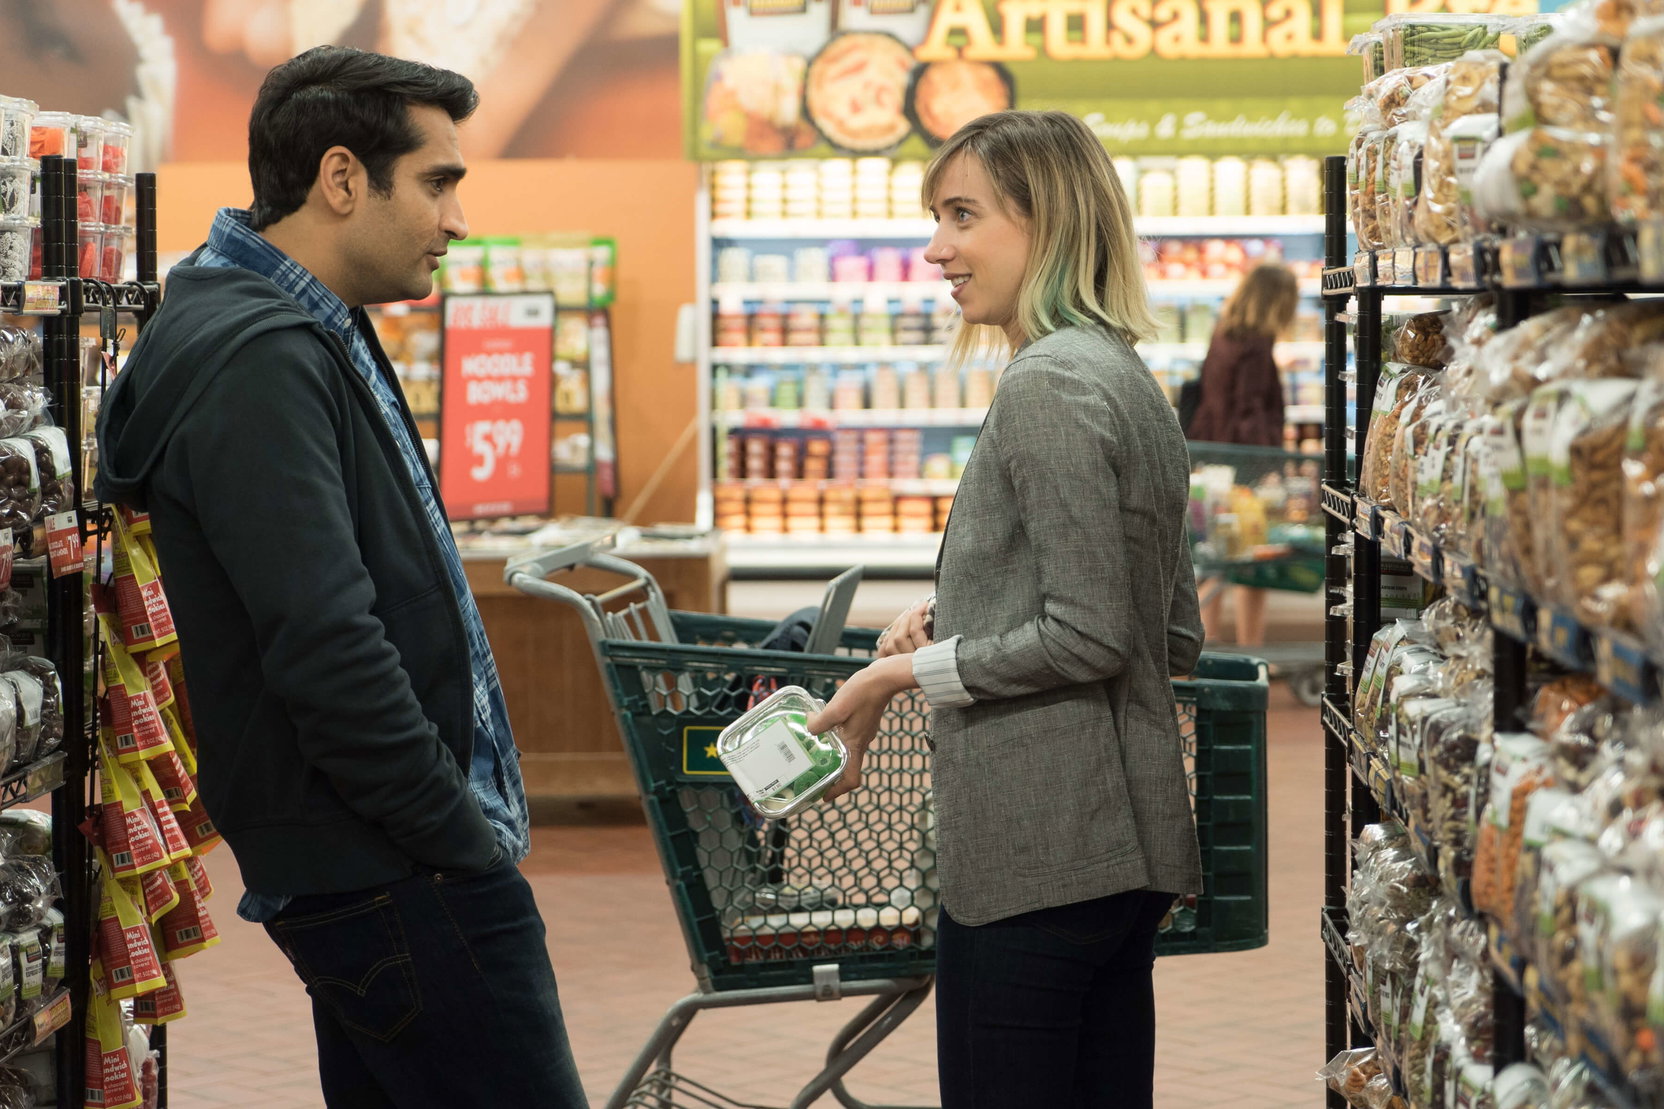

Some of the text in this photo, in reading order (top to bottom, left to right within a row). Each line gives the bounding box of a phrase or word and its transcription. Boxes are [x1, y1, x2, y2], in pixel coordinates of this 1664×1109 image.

[911, 0, 1345, 61] Artisanal
[1154, 112, 1177, 140] &
[1179, 110, 1310, 139] Sandwiches
[461, 351, 535, 377] NOODLE
[466, 379, 529, 404] BOWLS
[126, 930, 141, 940] Mini
[104, 1054, 120, 1065] Mini
